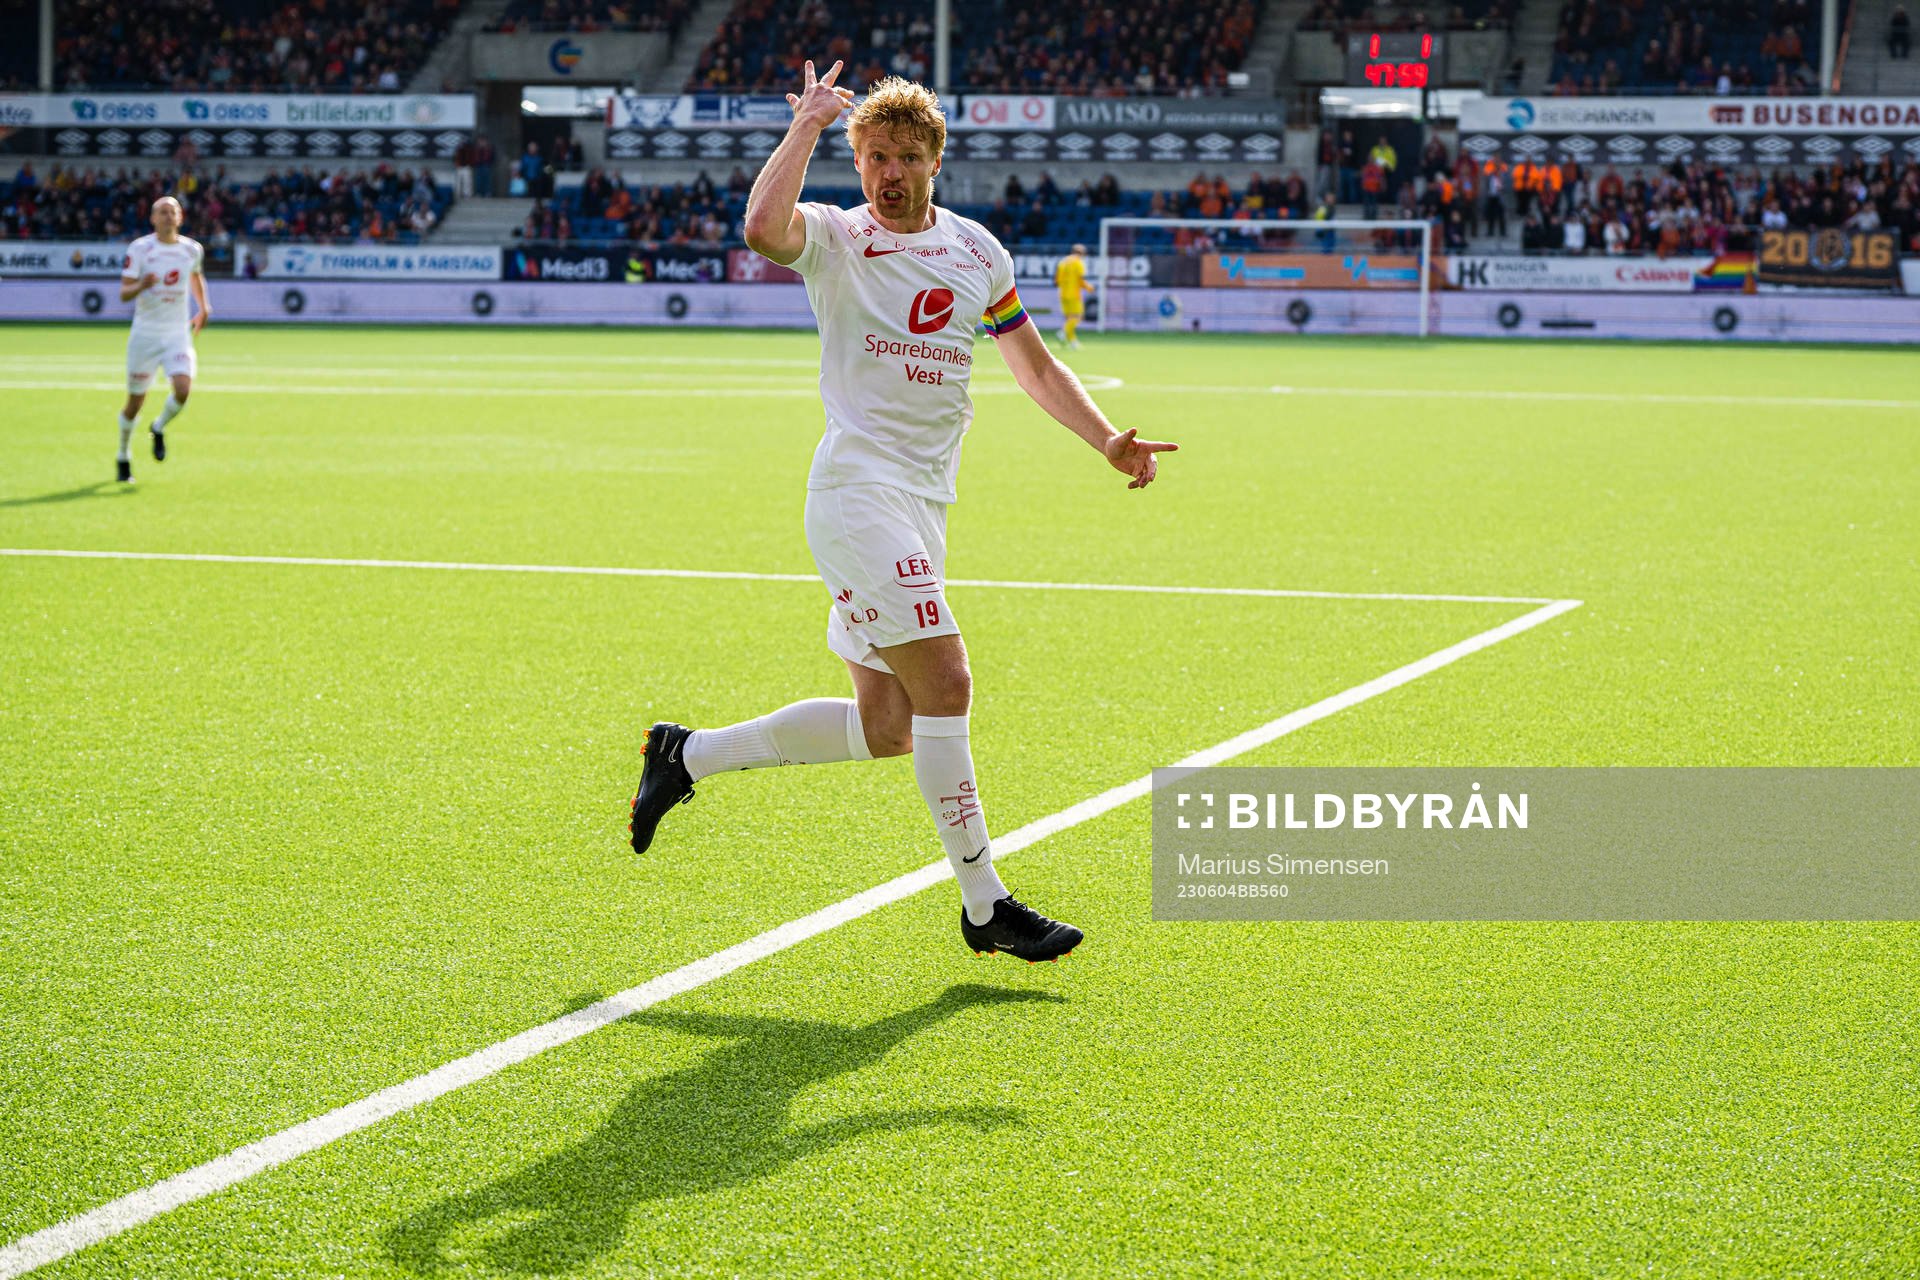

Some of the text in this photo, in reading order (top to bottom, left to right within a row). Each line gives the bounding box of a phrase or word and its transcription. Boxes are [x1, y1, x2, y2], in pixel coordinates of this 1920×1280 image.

[102, 103, 157, 120] OBOS
[214, 103, 270, 121] OBOS
[286, 102, 393, 122] brilleland
[1063, 102, 1161, 124] ADVISO
[541, 257, 609, 278] Medi3
[1615, 266, 1690, 284] Canon
[904, 363, 944, 386] Vest
[913, 600, 940, 629] 19
